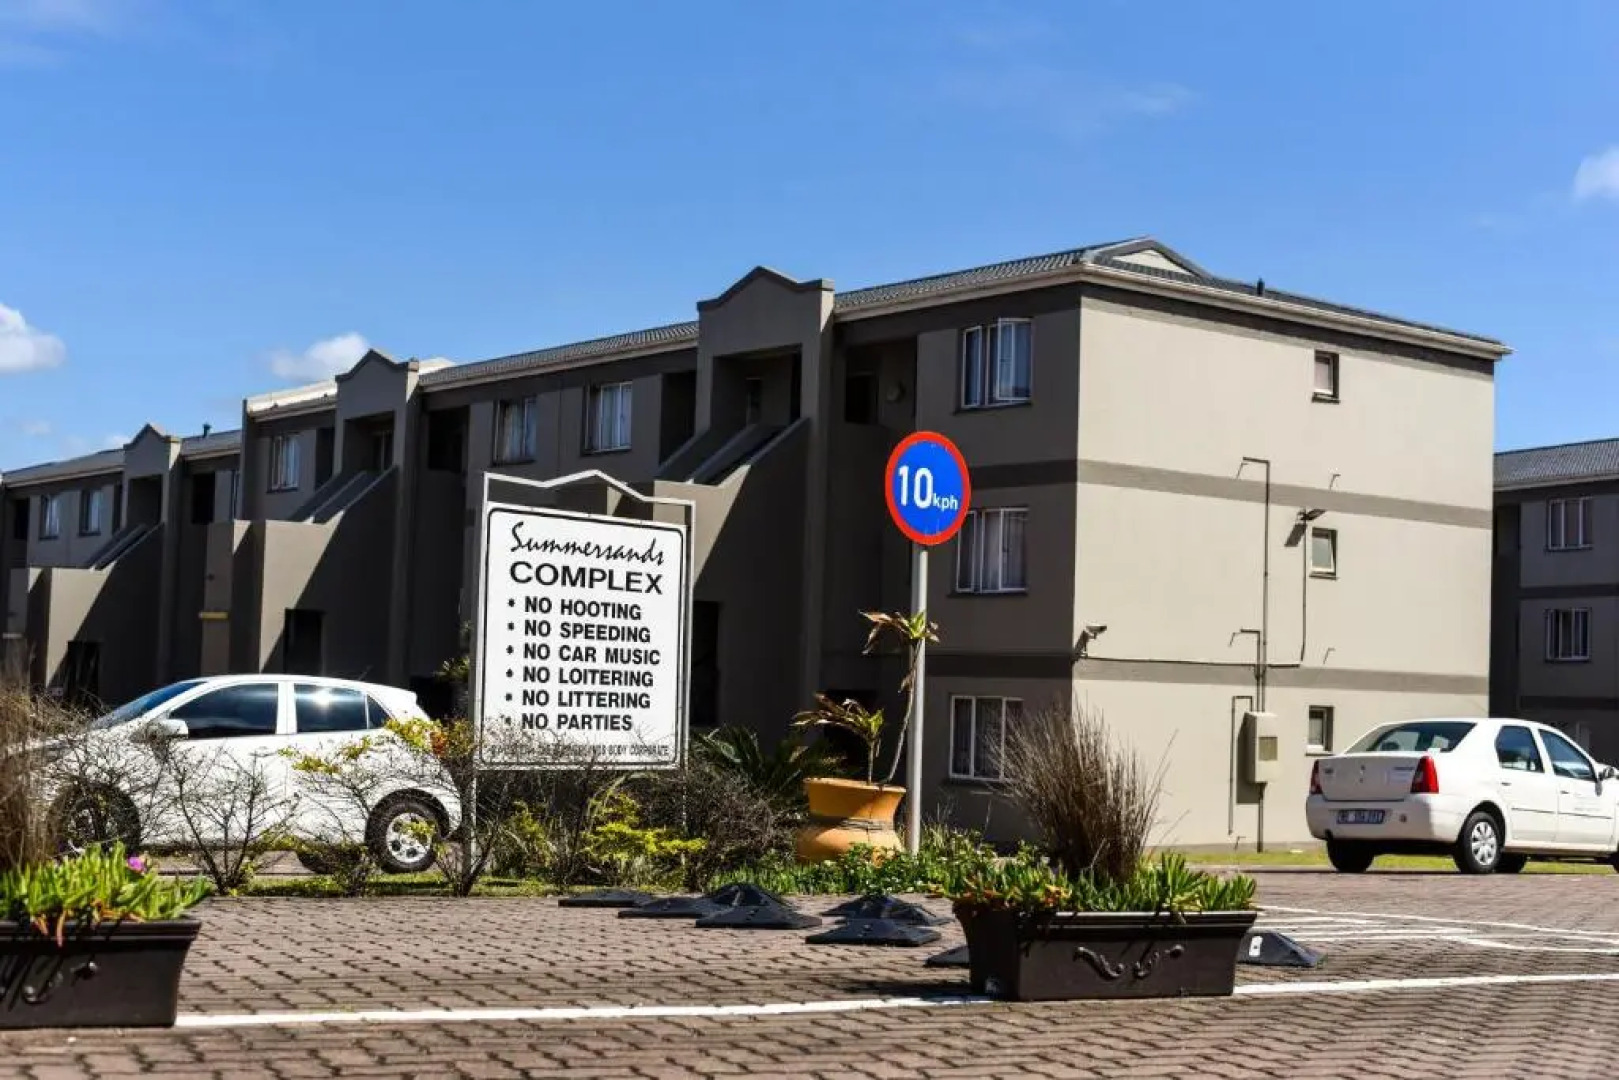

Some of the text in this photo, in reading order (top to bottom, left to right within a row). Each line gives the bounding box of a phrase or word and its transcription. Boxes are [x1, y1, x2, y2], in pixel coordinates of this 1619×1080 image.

[510, 521, 665, 566] Summersands
[509, 560, 663, 595] COMPLEX
[524, 596, 641, 620] NO HOOTING
[524, 619, 651, 643] NO SPEEDING
[523, 643, 661, 665] NO CAR MUSIC
[522, 666, 654, 687] NO LOITERING
[522, 689, 651, 709] NO LITTERING
[521, 713, 633, 731] NO PARTIES
